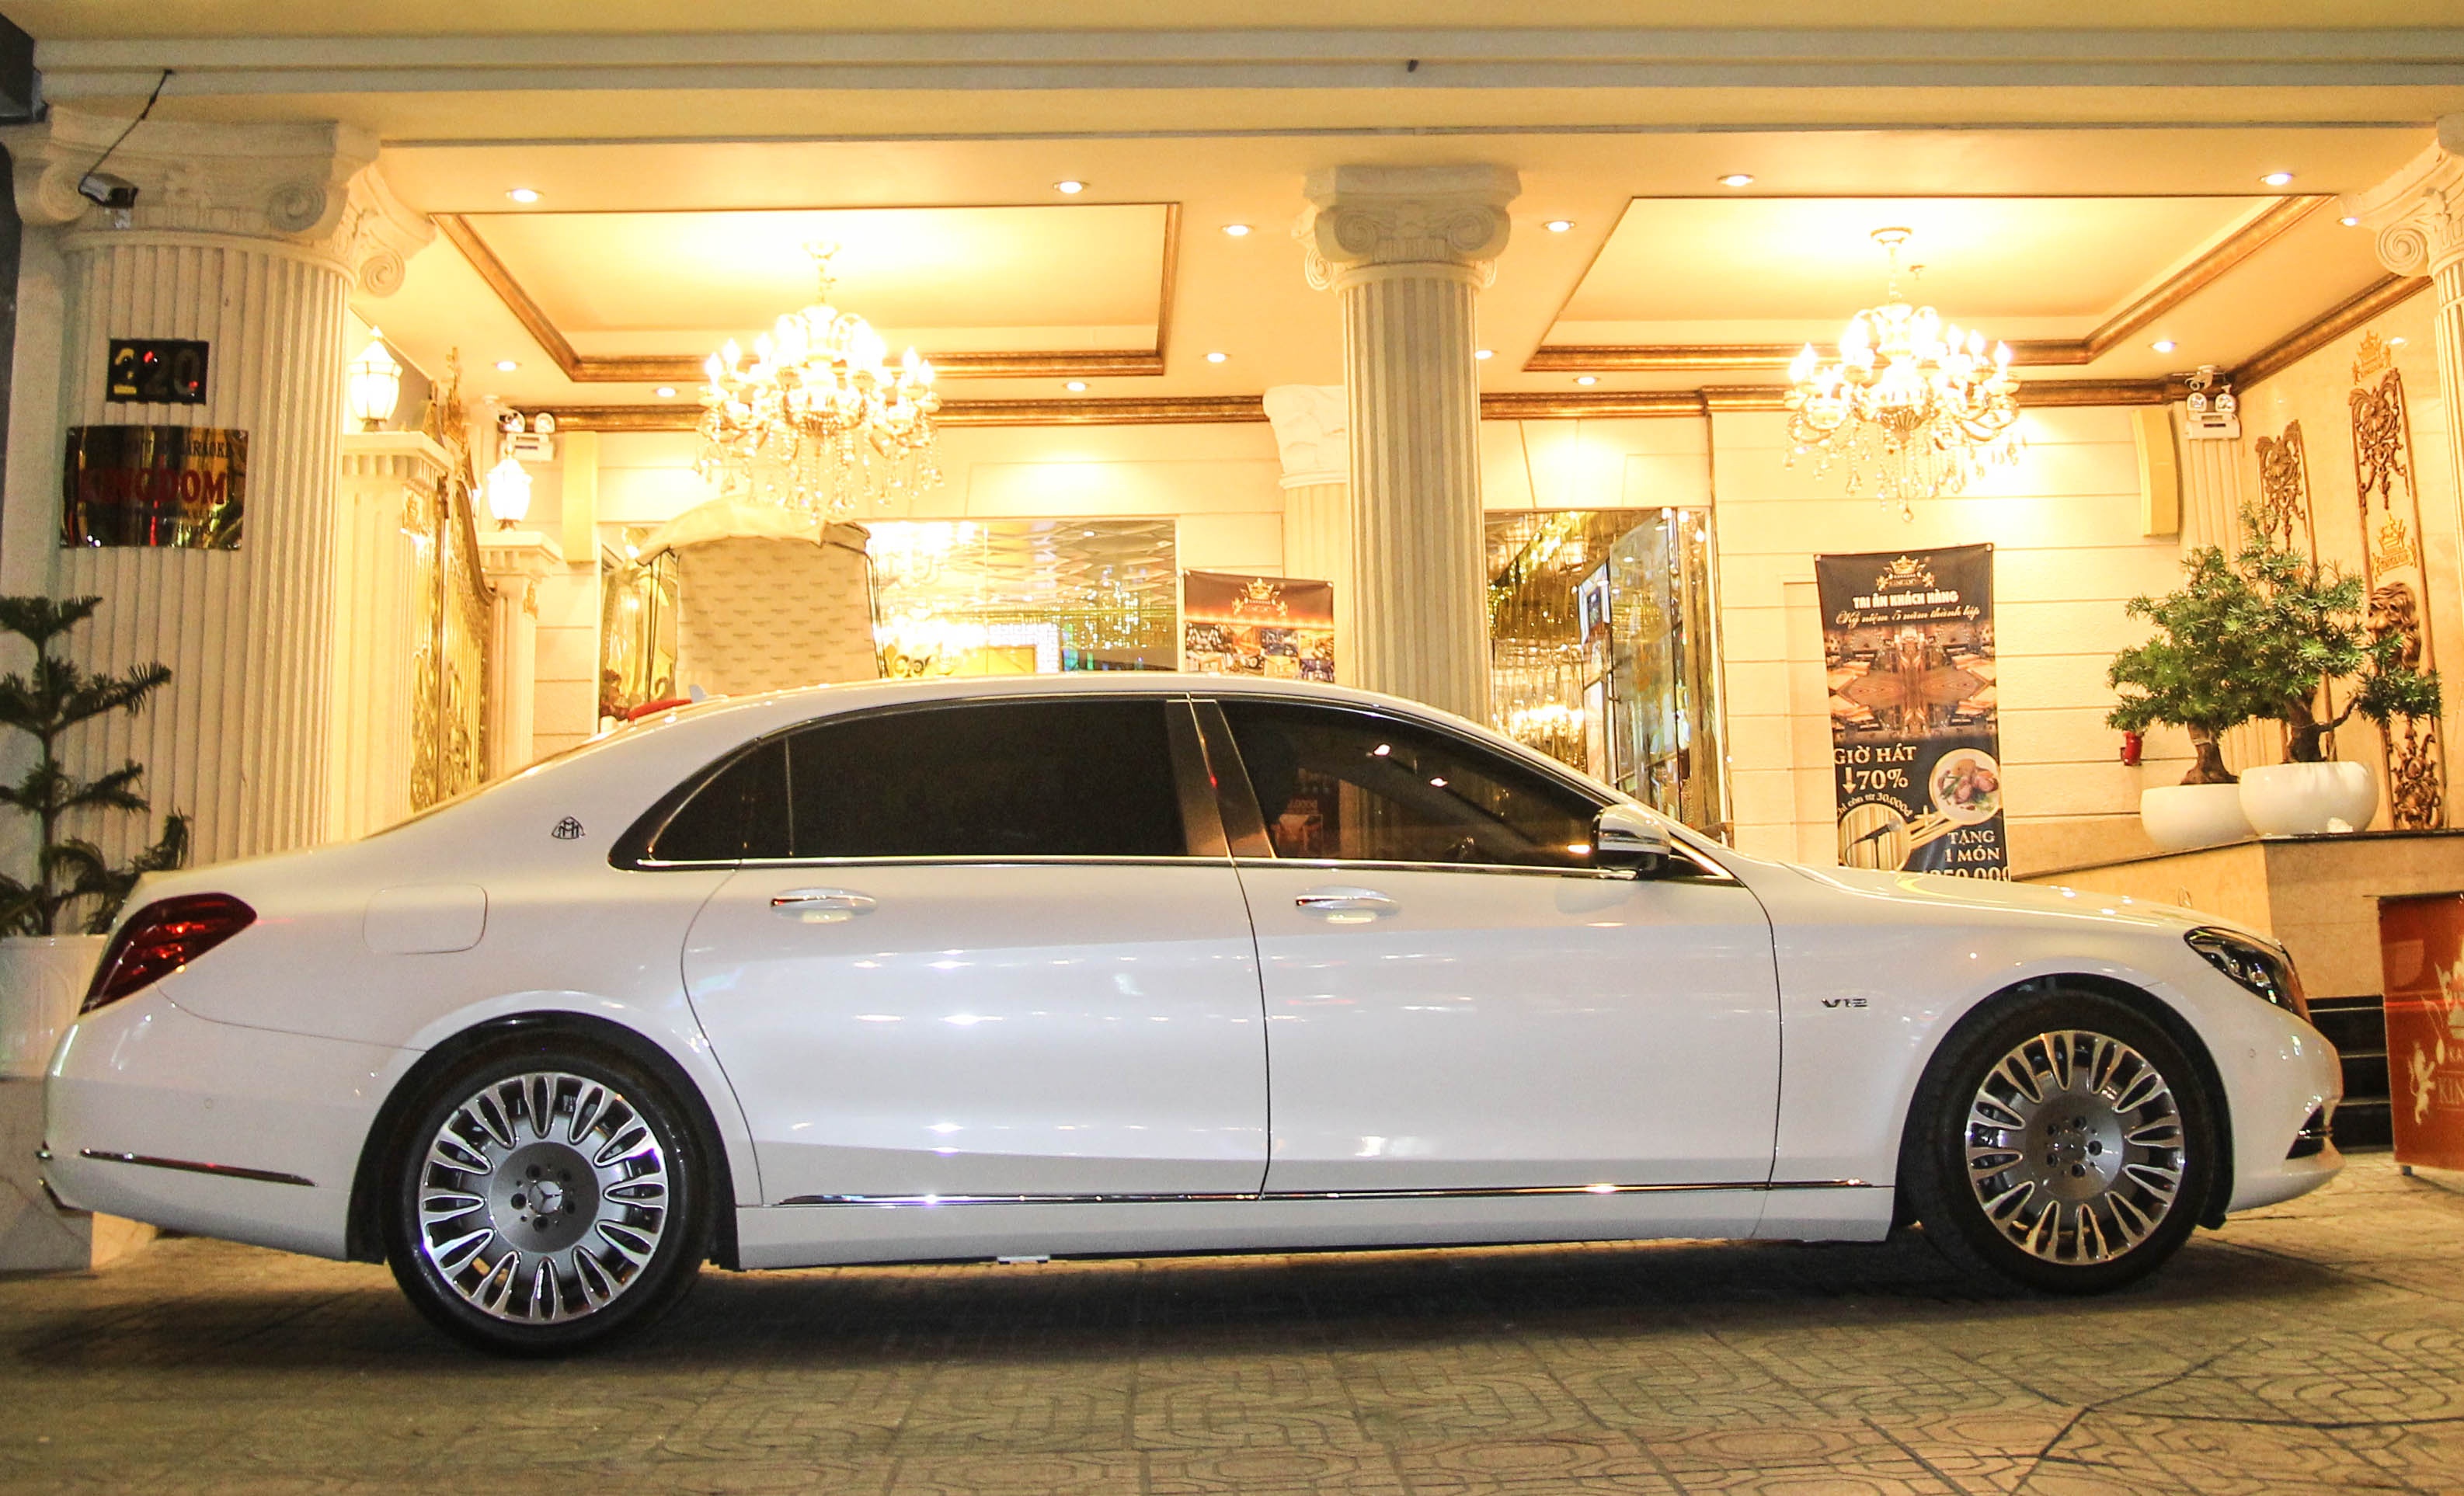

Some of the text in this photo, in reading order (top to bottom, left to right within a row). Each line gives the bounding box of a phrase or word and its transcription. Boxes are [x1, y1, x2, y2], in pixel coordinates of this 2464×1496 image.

[113, 348, 200, 395] 220
[1889, 590, 1925, 607] KHÁCH
[1926, 588, 1959, 604] HÀNG
[1834, 743, 1917, 764] GIỜ HÁT
[1857, 768, 1909, 791] 70%
[1947, 830, 1996, 845] TẶNG
[1945, 845, 2000, 862] 1 MÓN
[1821, 998, 1868, 1008] V12
